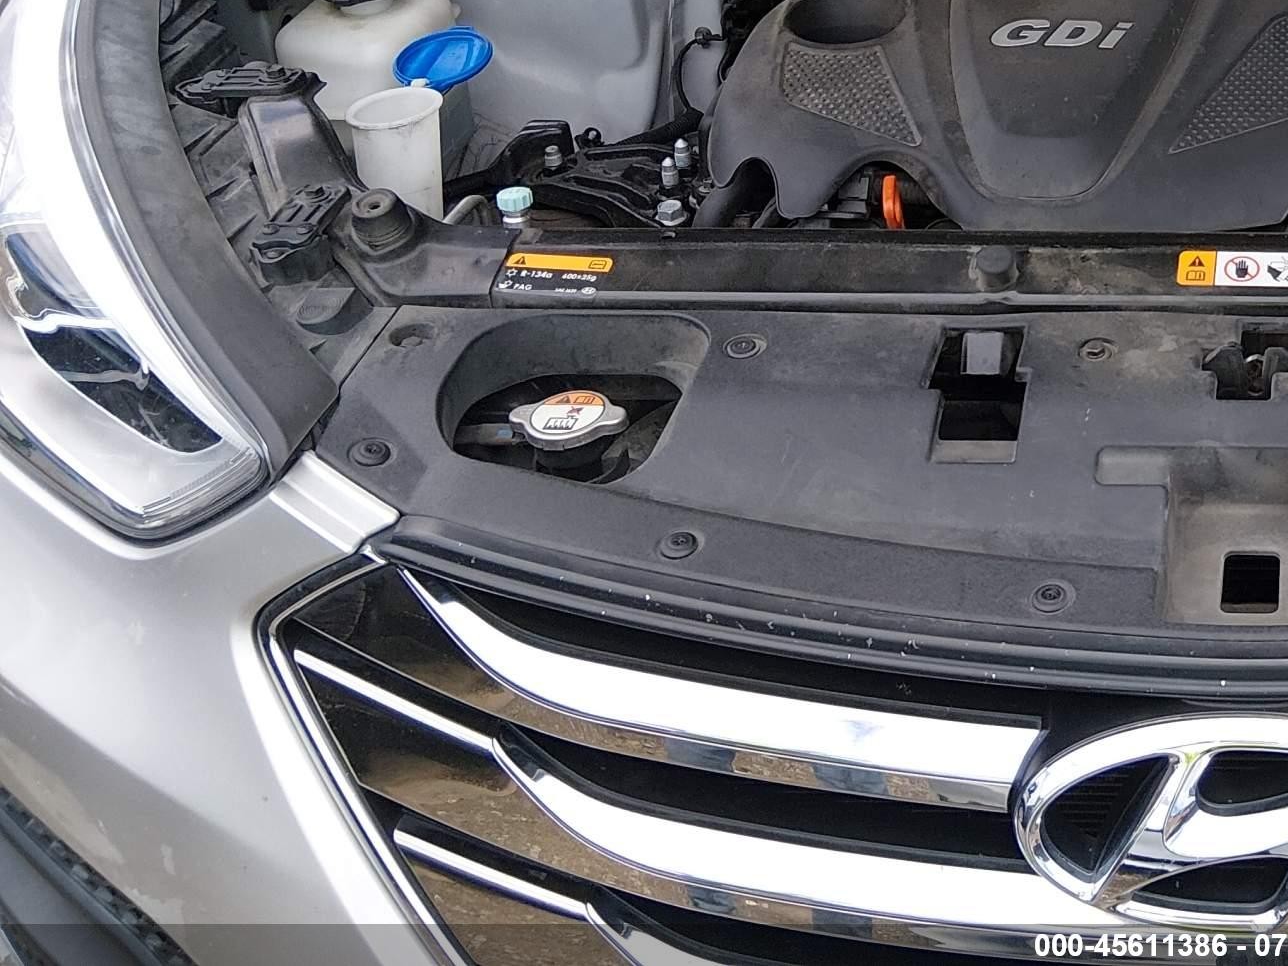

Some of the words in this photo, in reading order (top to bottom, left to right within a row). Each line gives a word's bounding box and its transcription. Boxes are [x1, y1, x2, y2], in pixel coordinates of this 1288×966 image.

[990, 19, 1135, 49] GDi
[520, 269, 553, 279] R-134a
[513, 283, 533, 291] PAG
